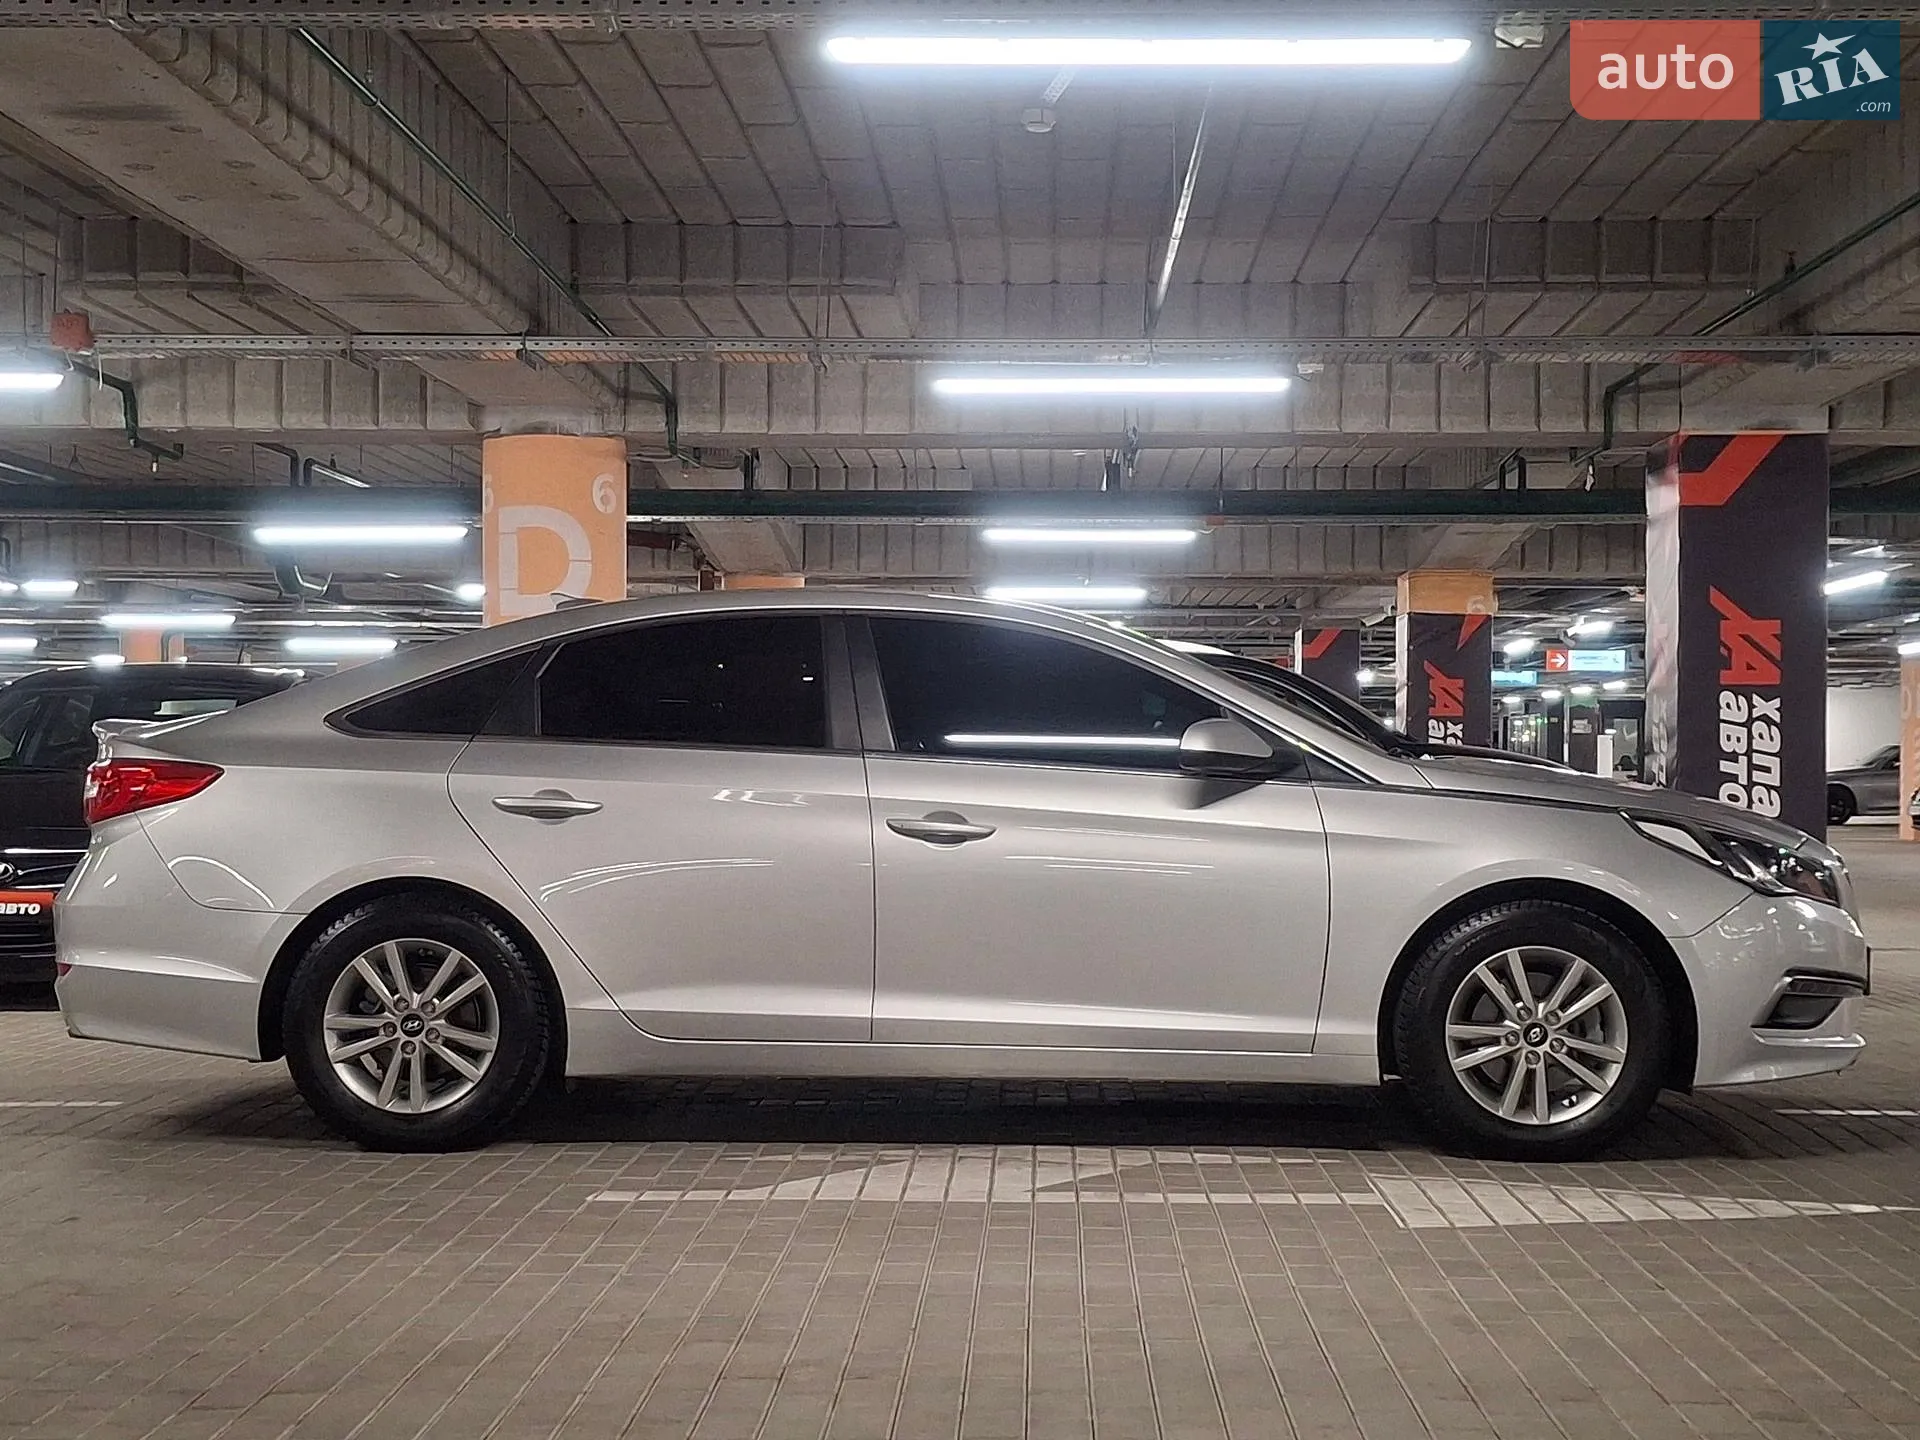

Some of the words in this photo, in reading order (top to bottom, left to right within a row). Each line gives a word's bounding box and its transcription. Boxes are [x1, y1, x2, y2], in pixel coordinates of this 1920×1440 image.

[592, 473, 617, 514] 6
[499, 504, 592, 616] D
[1719, 689, 1749, 811] авто
[1752, 692, 1782, 818] хапа
